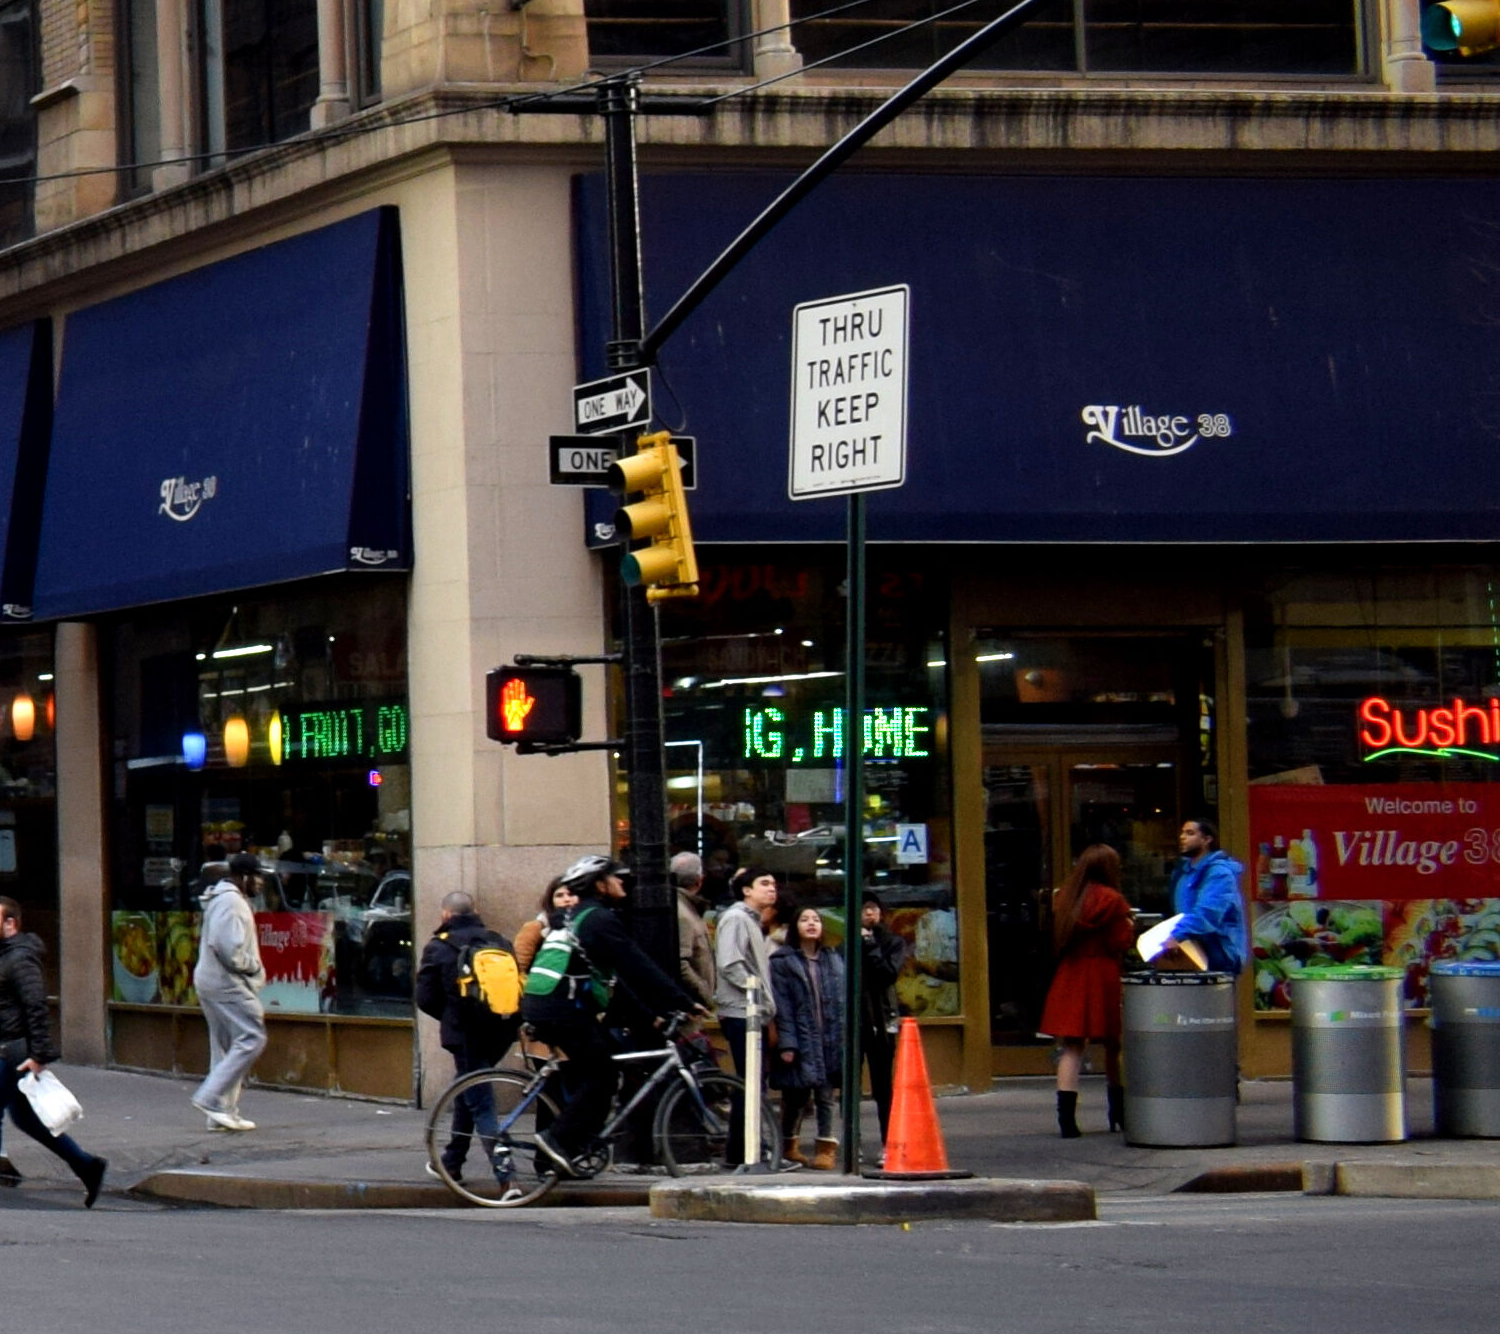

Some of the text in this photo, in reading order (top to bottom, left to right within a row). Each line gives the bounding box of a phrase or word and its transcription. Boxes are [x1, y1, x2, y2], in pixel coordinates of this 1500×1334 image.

[818, 307, 883, 347] THRU
[806, 348, 893, 390] TRAFFIC
[583, 389, 639, 420] ONE WAY
[816, 391, 879, 429] KEEP
[1081, 404, 1232, 455] Village 38
[570, 450, 612, 471] ONE
[810, 434, 883, 473] RIGHT
[1360, 696, 1500, 748] Sushi
[1365, 797, 1477, 815] Welcome to
[902, 828, 922, 853] A
[1332, 827, 1459, 875] Village
[257, 921, 291, 955] illage
